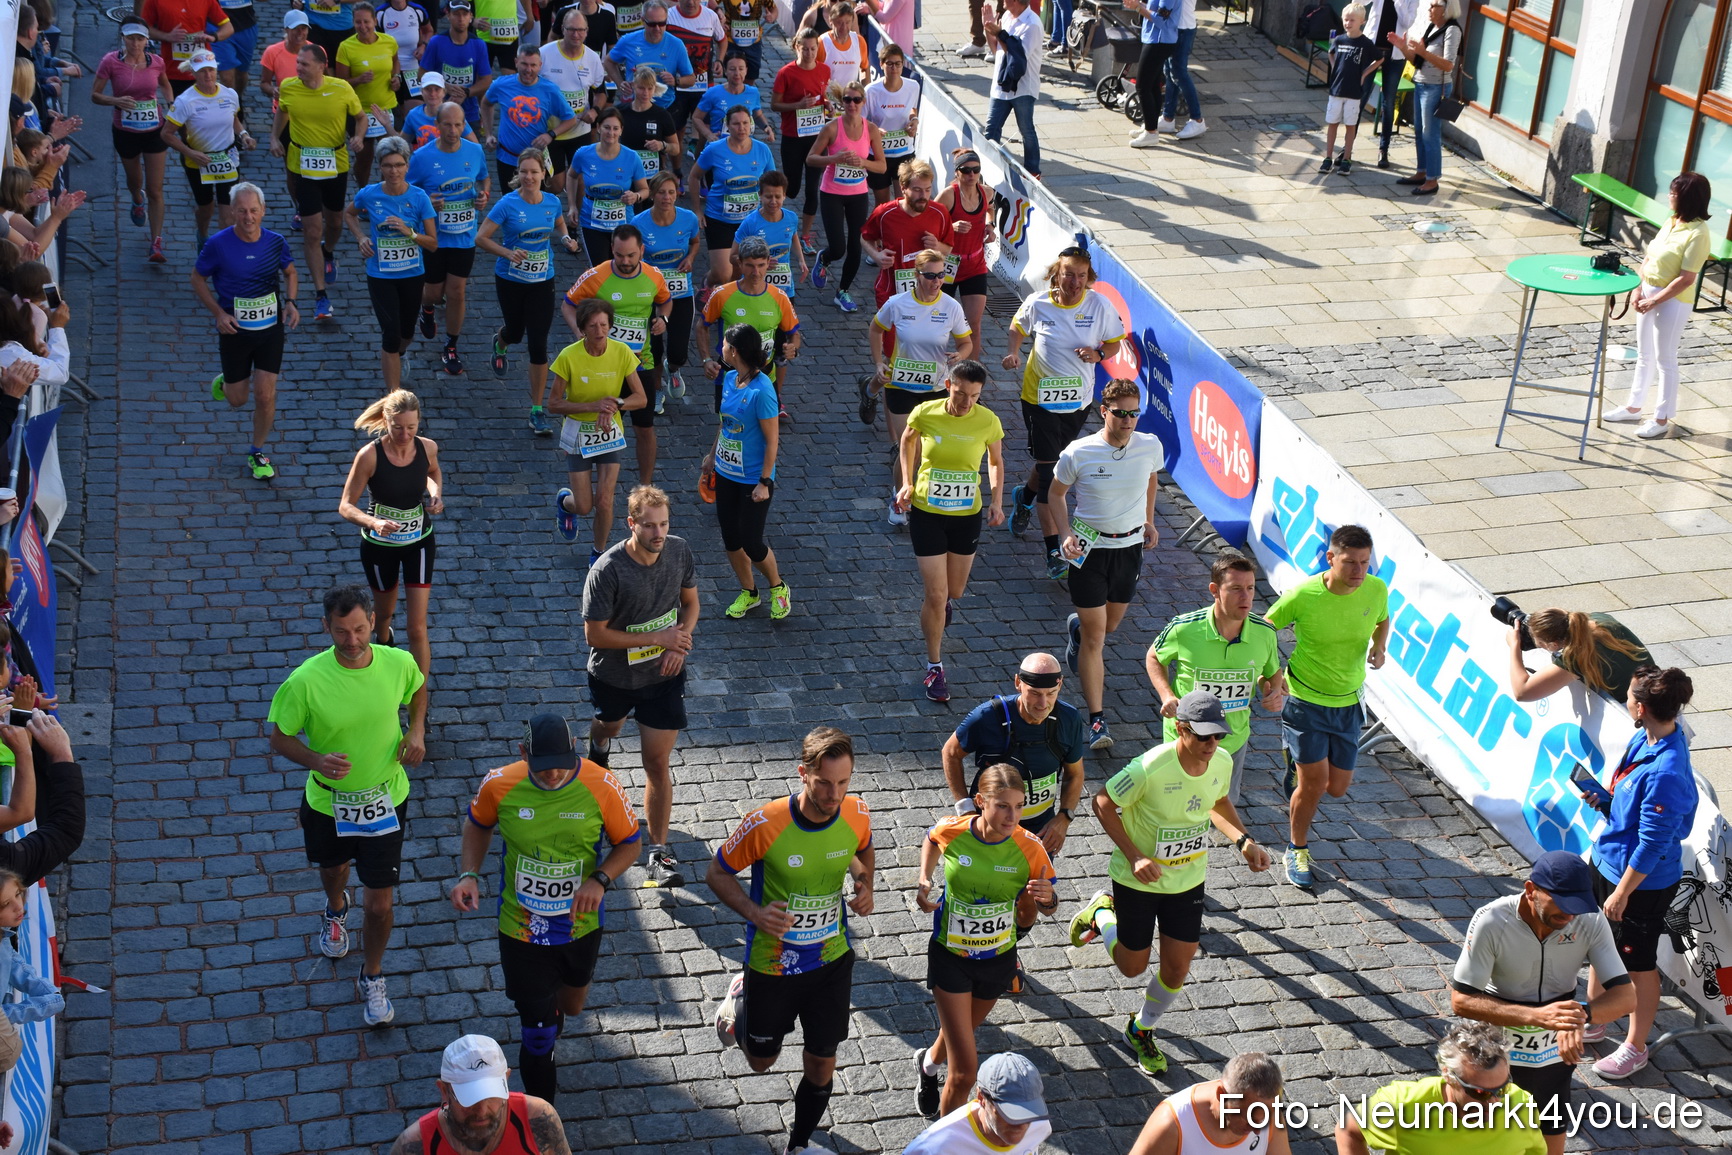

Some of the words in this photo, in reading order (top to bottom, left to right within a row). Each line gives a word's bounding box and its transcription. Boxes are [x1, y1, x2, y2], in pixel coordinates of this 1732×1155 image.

[621, 13, 642, 23] 1245
[494, 28, 516, 36] 1031
[735, 29, 757, 38] 2661
[445, 74, 470, 84] 2253
[566, 100, 583, 108] 055
[126, 111, 155, 120] 2129
[798, 107, 823, 115] BOCK
[801, 116, 822, 126] 2567
[882, 138, 906, 148] 2720
[303, 148, 332, 156] BOCK
[205, 162, 232, 173] 1029
[304, 158, 332, 169] 1397
[839, 169, 865, 178] 2788
[728, 203, 755, 213] 2362
[444, 211, 472, 223] 2368
[595, 209, 623, 220] 2366
[381, 239, 415, 247] BOCK
[383, 248, 415, 260] 2370
[526, 251, 548, 260] OCK
[515, 261, 545, 272] 2367
[517, 271, 539, 279] NICOLE
[239, 299, 275, 307] BOCK
[240, 307, 273, 320] 2814
[611, 327, 642, 341] 2734
[898, 360, 933, 371] BOCK
[897, 371, 931, 384] 2748
[1042, 378, 1079, 387] BOCK
[1153, 367, 1173, 396] ONLINE
[1043, 389, 1078, 401] 2752
[1151, 394, 1173, 423] MOBILE
[584, 427, 617, 446] 2207
[1194, 386, 1250, 484] Hervis
[586, 441, 621, 453] GABRIELE
[1201, 444, 1222, 475] SPORTS
[933, 471, 974, 482] BOCK
[933, 484, 971, 497] 2211
[380, 507, 421, 519] BOCK
[387, 533, 416, 541] ANUELA
[1201, 671, 1249, 681] BOCK
[1201, 683, 1246, 698] 2212
[337, 788, 382, 803] BOCK
[339, 800, 386, 822] 2765
[726, 810, 767, 854] BOCK
[1165, 825, 1207, 840] BOCK
[1164, 837, 1202, 857] 1258
[827, 849, 848, 859] BOCK
[1170, 857, 1191, 866] PETR
[525, 861, 575, 876] BOCK
[522, 877, 574, 898] 2509
[525, 898, 567, 910] MARKUS
[795, 895, 840, 909] BOCK
[955, 903, 1008, 917] BOCK
[793, 909, 837, 929] 2513
[958, 917, 1006, 934] 1284
[796, 929, 828, 940] MARCO
[961, 938, 1000, 946] SIMONE
